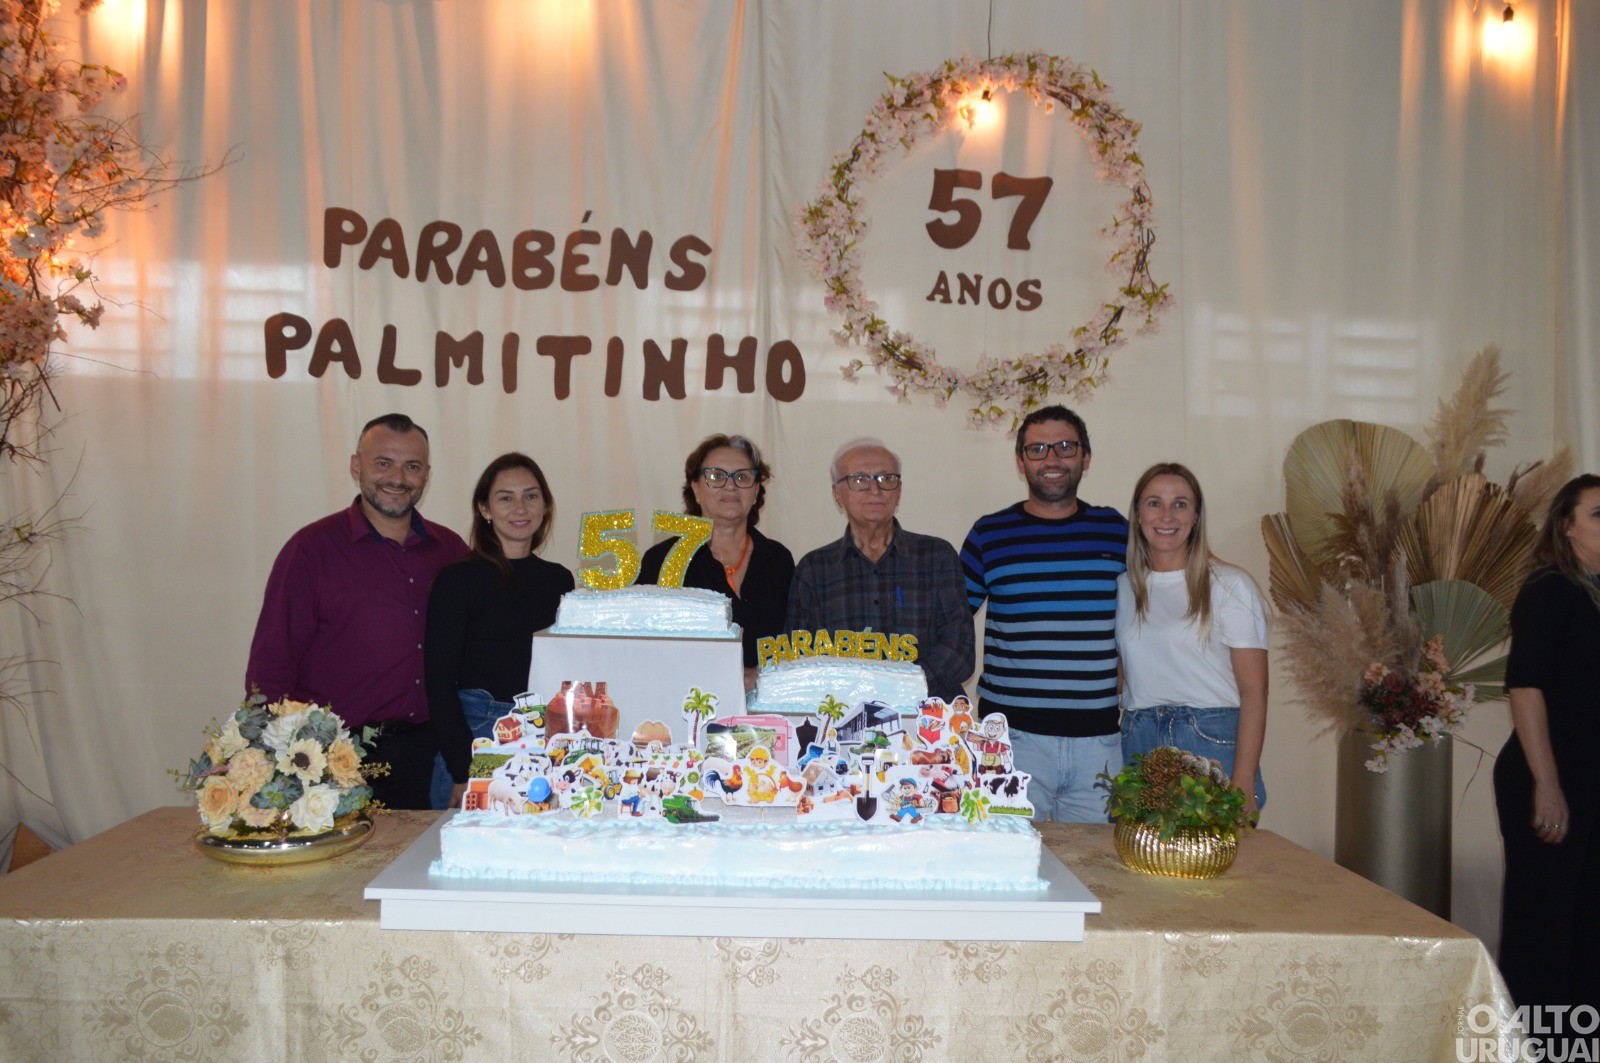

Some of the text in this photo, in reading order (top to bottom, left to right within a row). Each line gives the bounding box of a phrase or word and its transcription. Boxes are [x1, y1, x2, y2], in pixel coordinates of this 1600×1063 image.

[323, 206, 713, 292] PARABÉNS
[925, 168, 1053, 251] 57
[926, 270, 1043, 311] ANOS
[264, 312, 806, 402] PALMITINHO
[577, 508, 714, 592] 57
[757, 626, 919, 669] PARABÉNS
